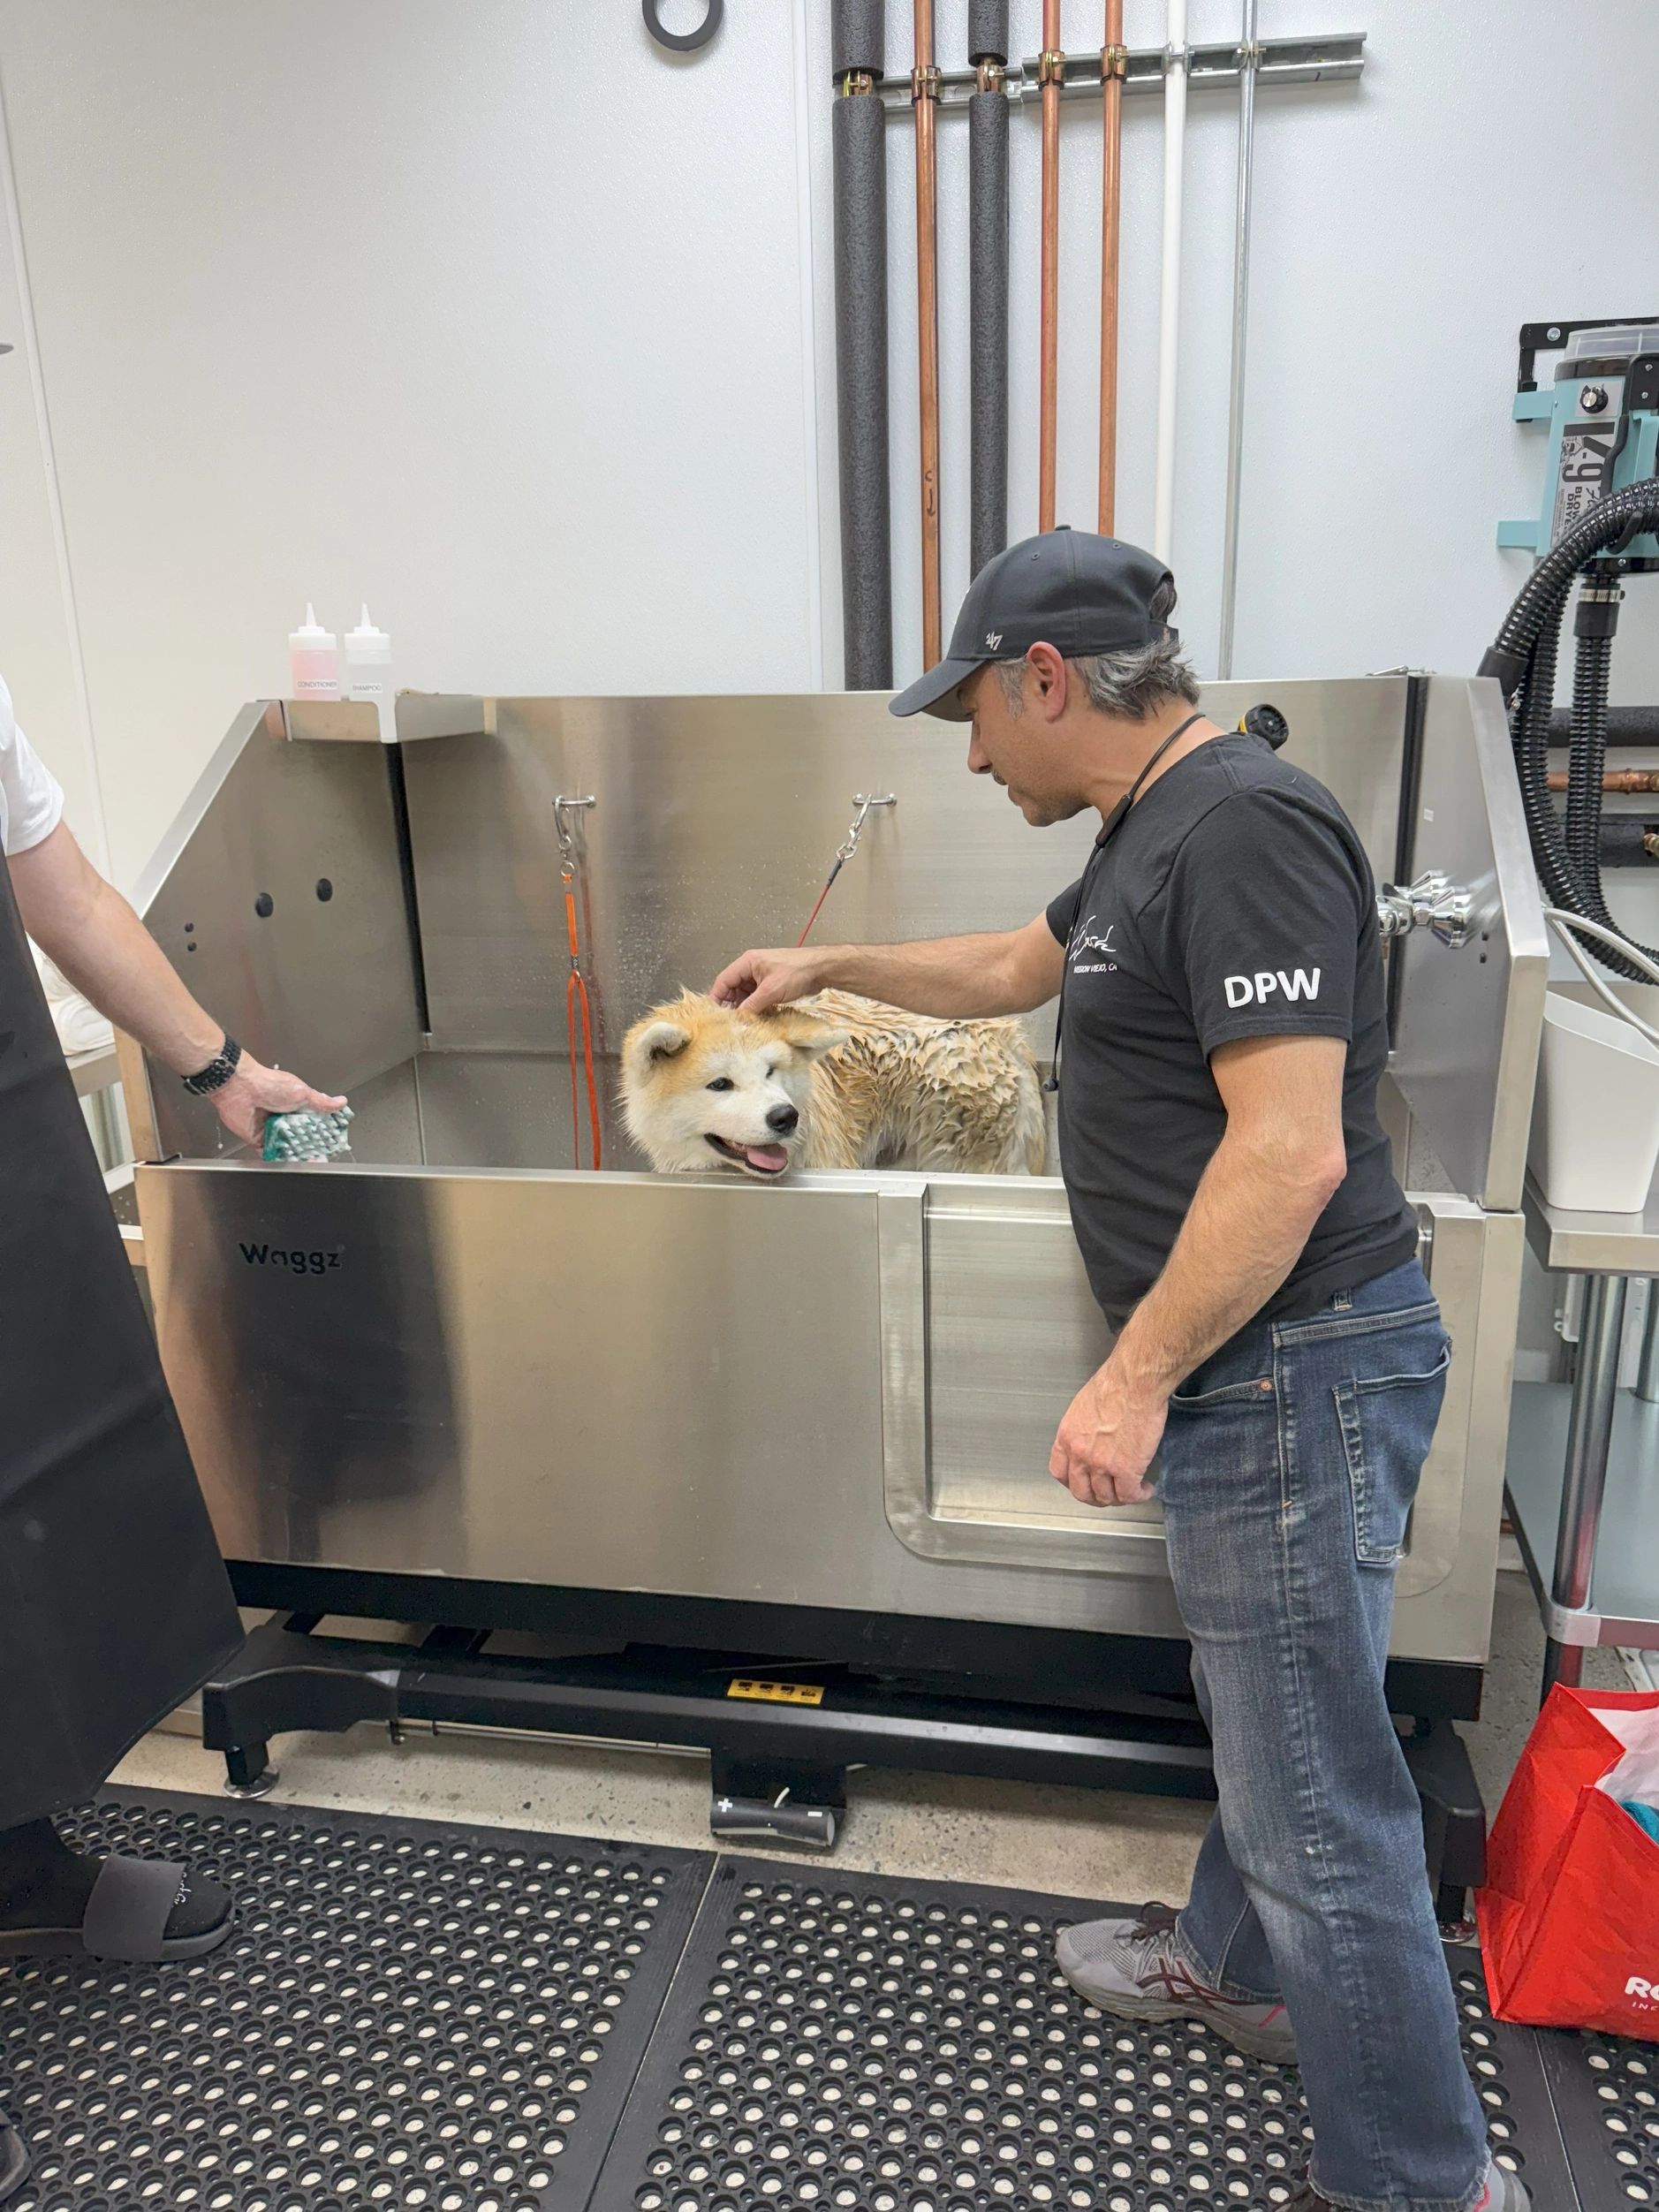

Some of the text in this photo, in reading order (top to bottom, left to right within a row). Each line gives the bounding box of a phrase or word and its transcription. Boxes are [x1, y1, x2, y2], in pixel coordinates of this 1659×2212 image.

[1564, 494, 1574, 530] DRYE
[1108, 963, 1117, 972] CA
[1223, 967, 1322, 1009] DPW
[239, 1243, 341, 1275] Waggz
